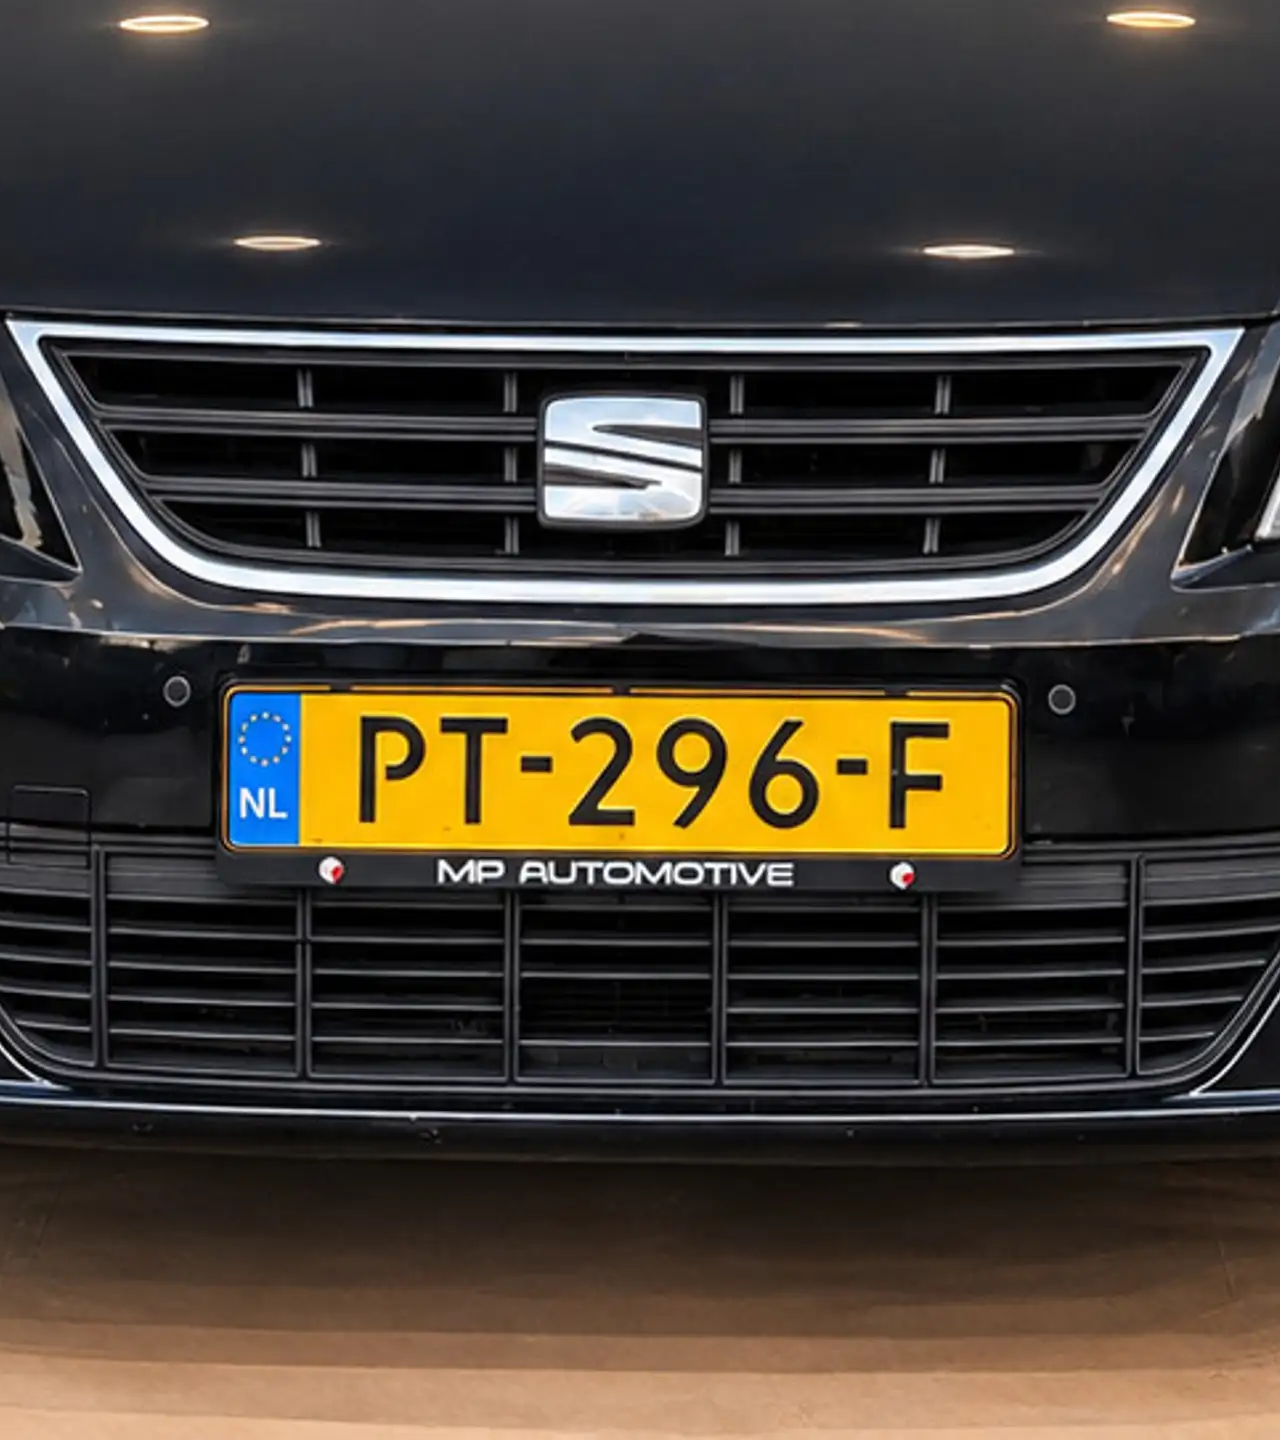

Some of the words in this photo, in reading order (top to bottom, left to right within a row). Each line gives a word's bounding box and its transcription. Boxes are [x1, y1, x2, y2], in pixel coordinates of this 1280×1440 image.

[357, 714, 952, 830] PT-296-F
[238, 788, 288, 820] NL
[436, 859, 506, 885] MP
[519, 860, 795, 887] AUTOMOTIVE
